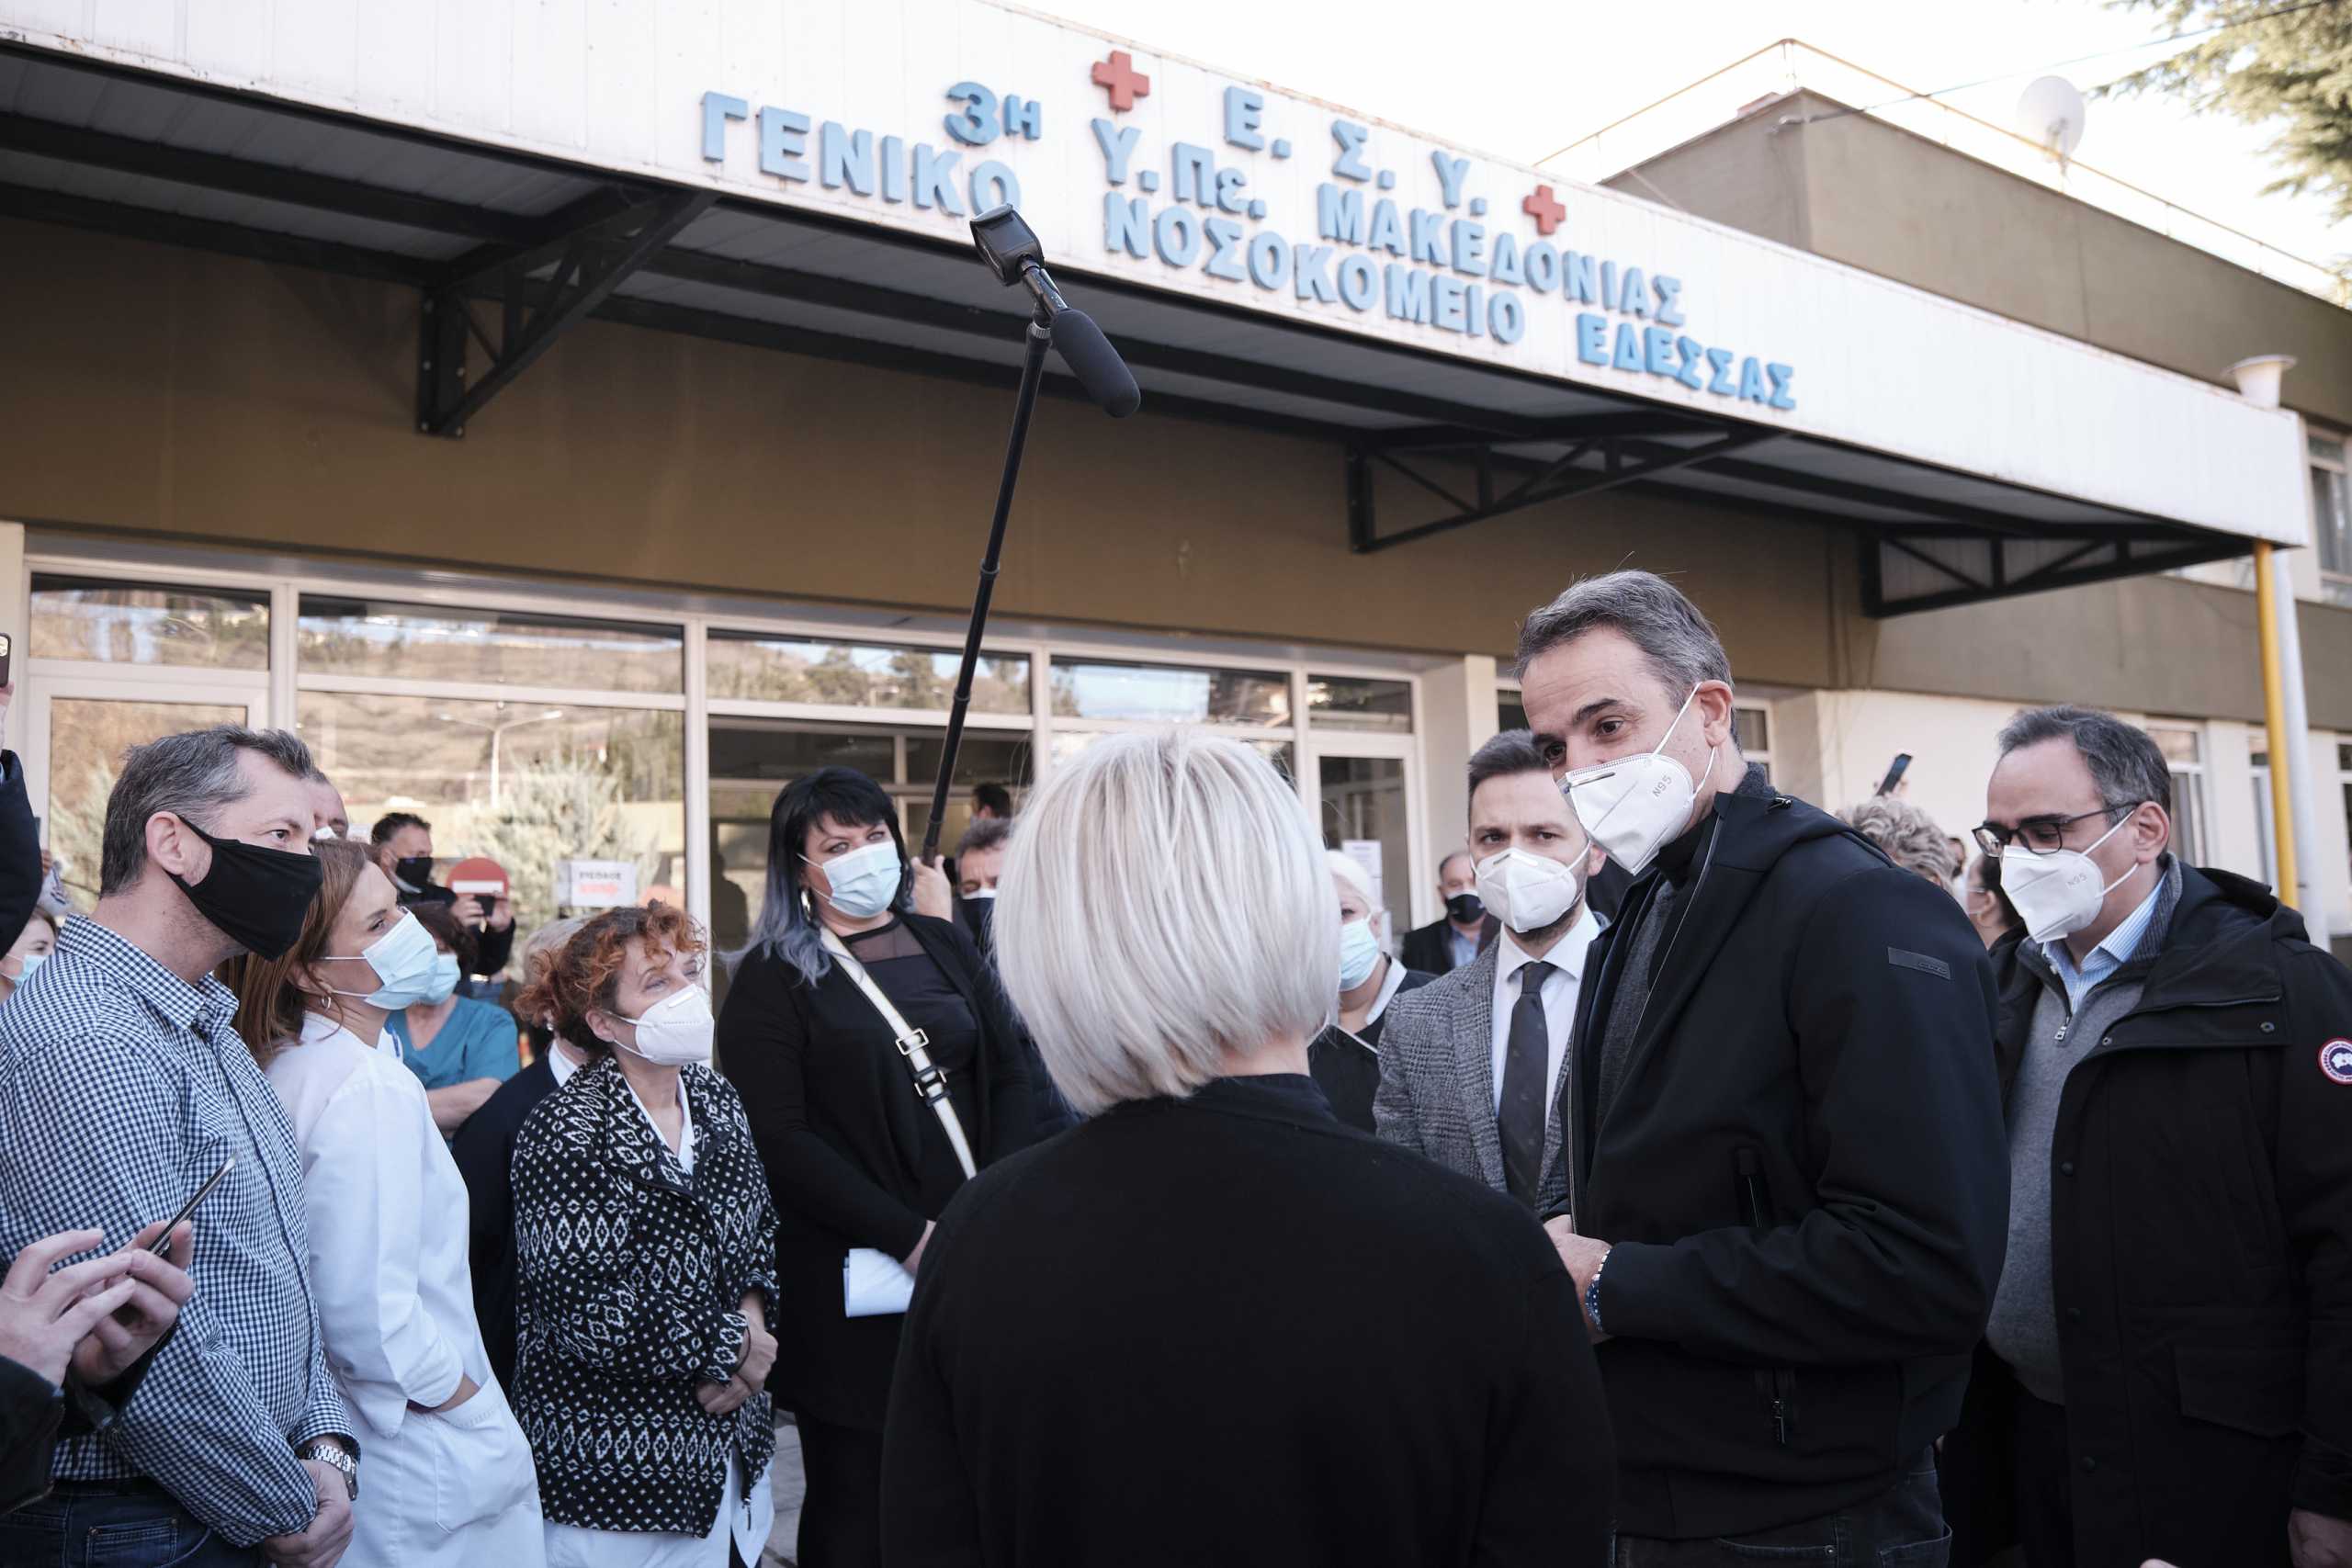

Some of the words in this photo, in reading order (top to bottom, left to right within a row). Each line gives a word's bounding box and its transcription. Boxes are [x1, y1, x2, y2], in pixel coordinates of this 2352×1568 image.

[1226, 88, 1291, 159] Ε.
[1331, 121, 1393, 190] Σ.
[1431, 151, 1487, 214] Υ.
[703, 91, 1021, 219] ΓΕΝΙΚΟ
[1105, 191, 1525, 344] ΝΟΣΟΚΟΜΕΙΟ
[1576, 312, 1796, 410] ΕΔΕΣΣΑΣ
[1317, 183, 1685, 325] ΜΑΚΕΔΟΝΙΑΣ
[1653, 775, 1672, 797] N95
